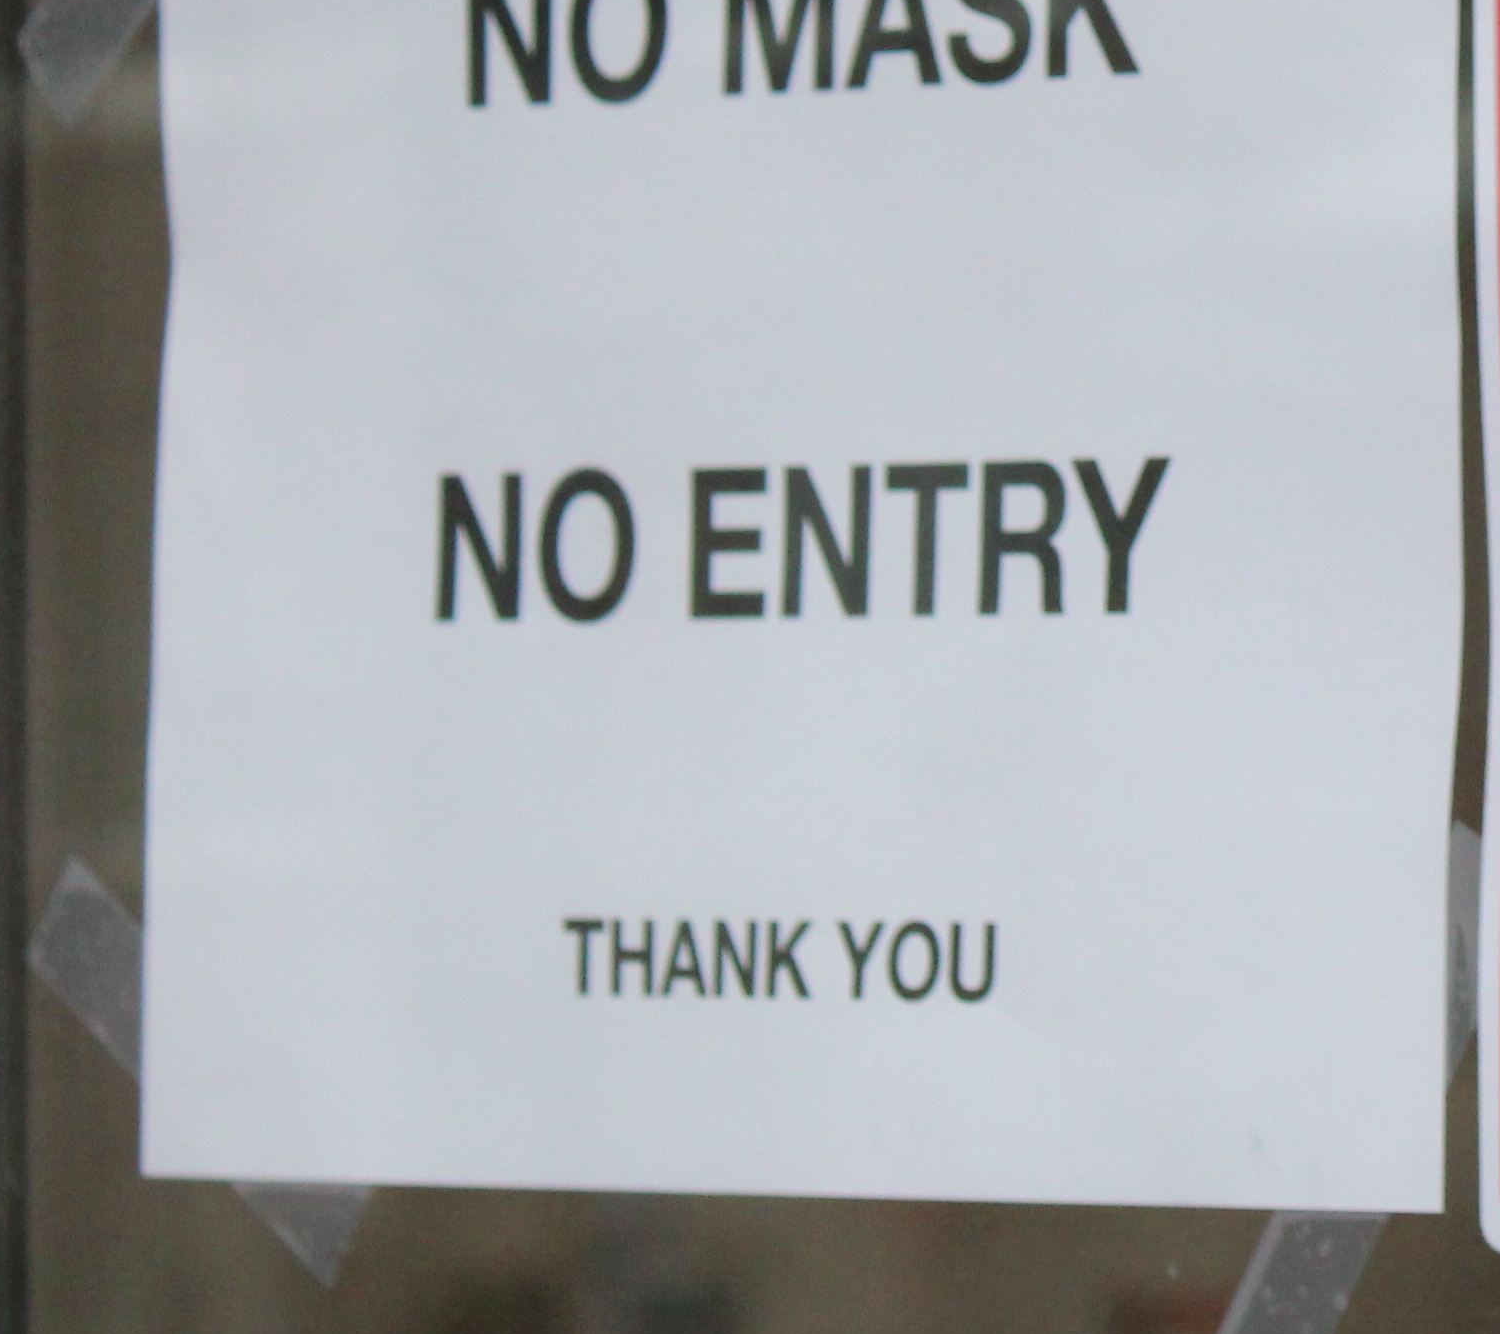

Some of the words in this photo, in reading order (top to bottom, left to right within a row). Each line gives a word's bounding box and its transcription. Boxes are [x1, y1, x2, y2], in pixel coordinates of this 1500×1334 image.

[438, 469, 634, 622] NO
[692, 458, 1169, 617] ENTRY
[567, 920, 807, 996] THANK
[841, 923, 994, 1001] YOU
